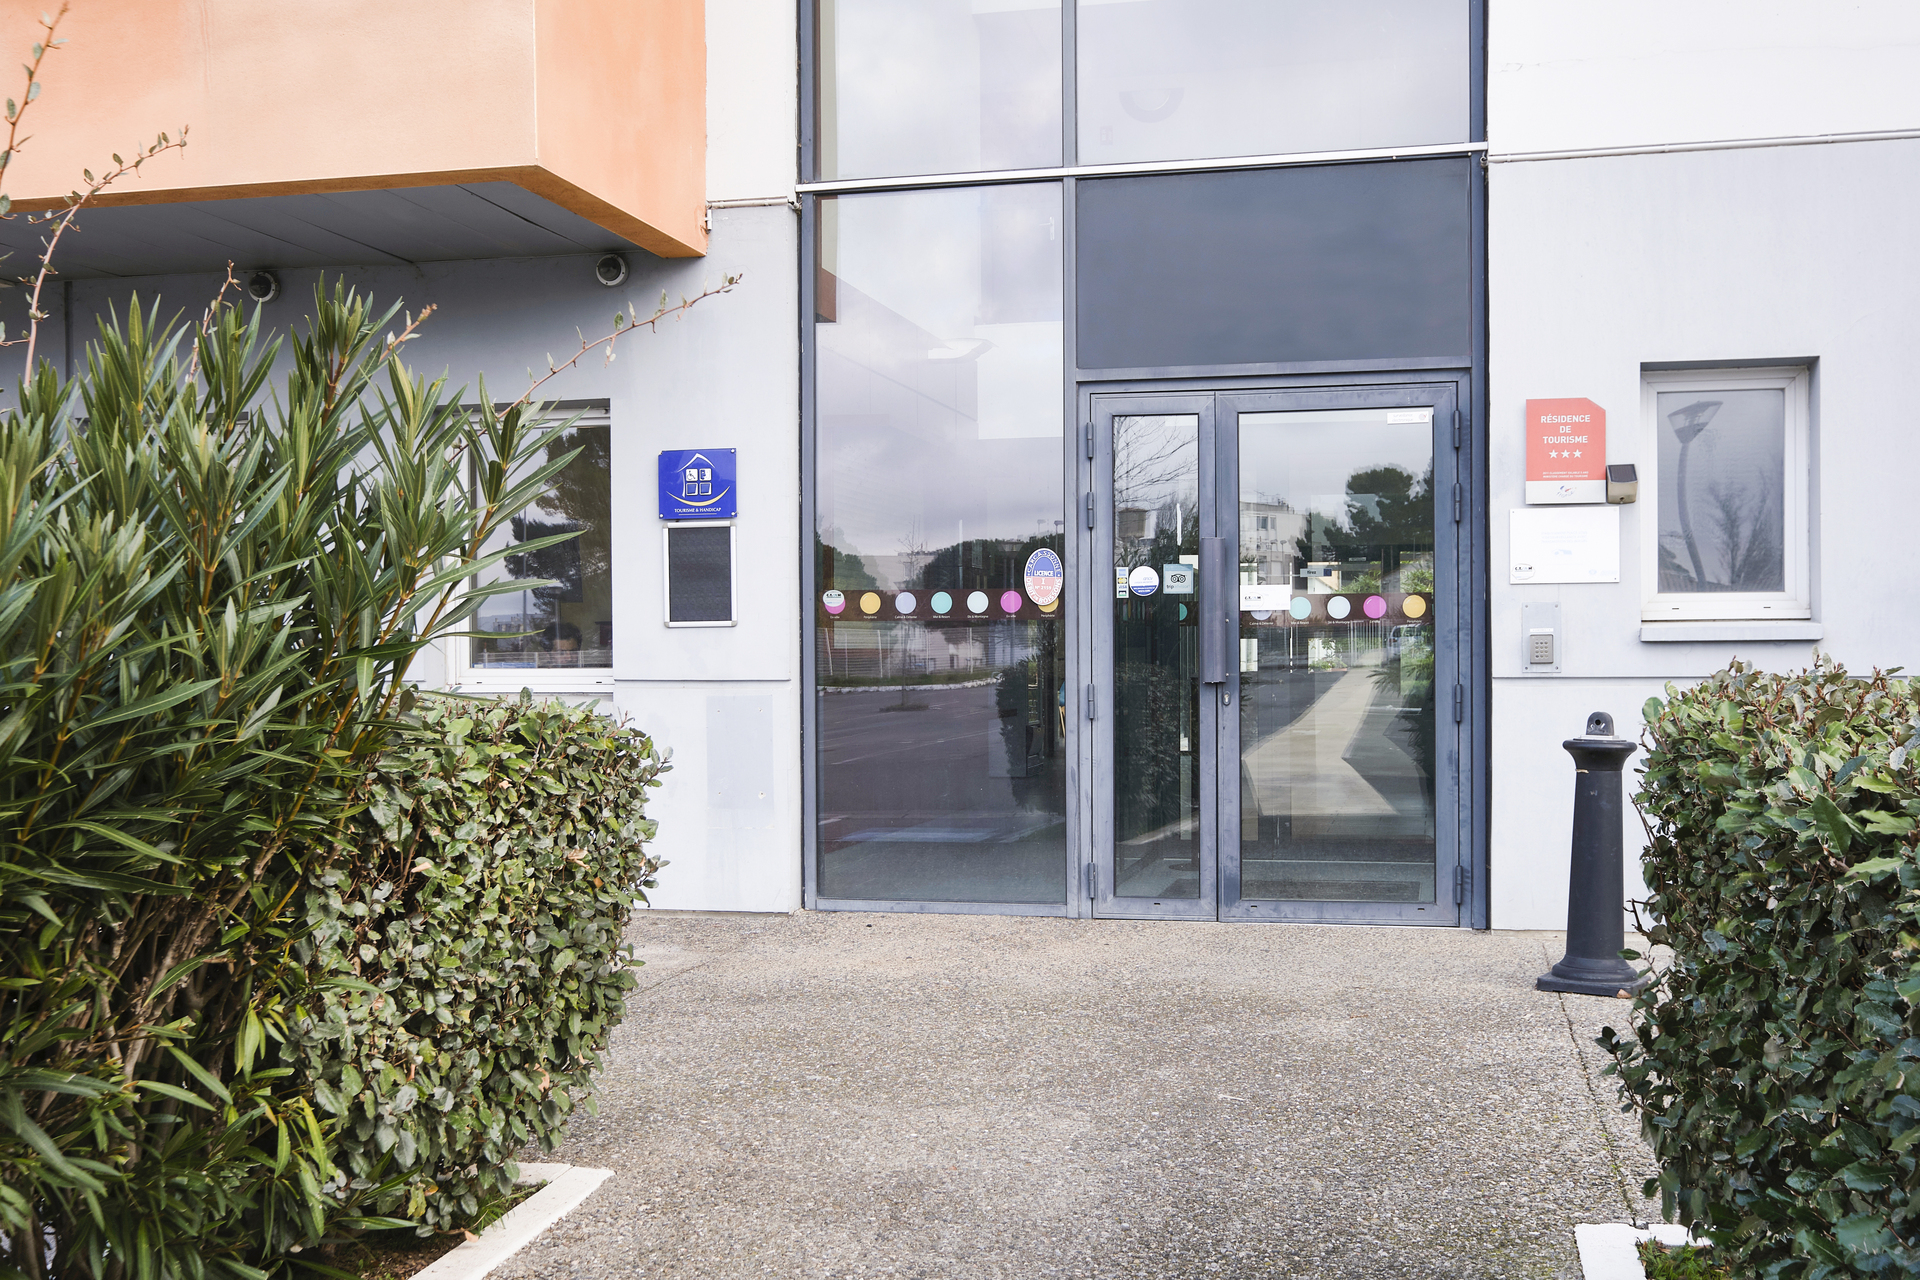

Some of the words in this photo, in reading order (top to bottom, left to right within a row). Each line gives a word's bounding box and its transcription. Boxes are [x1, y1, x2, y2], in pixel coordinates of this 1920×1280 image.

[1541, 413, 1590, 423] RÉSIDENCE
[1543, 435, 1588, 444] TOURISME
[1027, 550, 1061, 573] CARCASSONNE
[1039, 578, 1062, 603] BOISSONS
